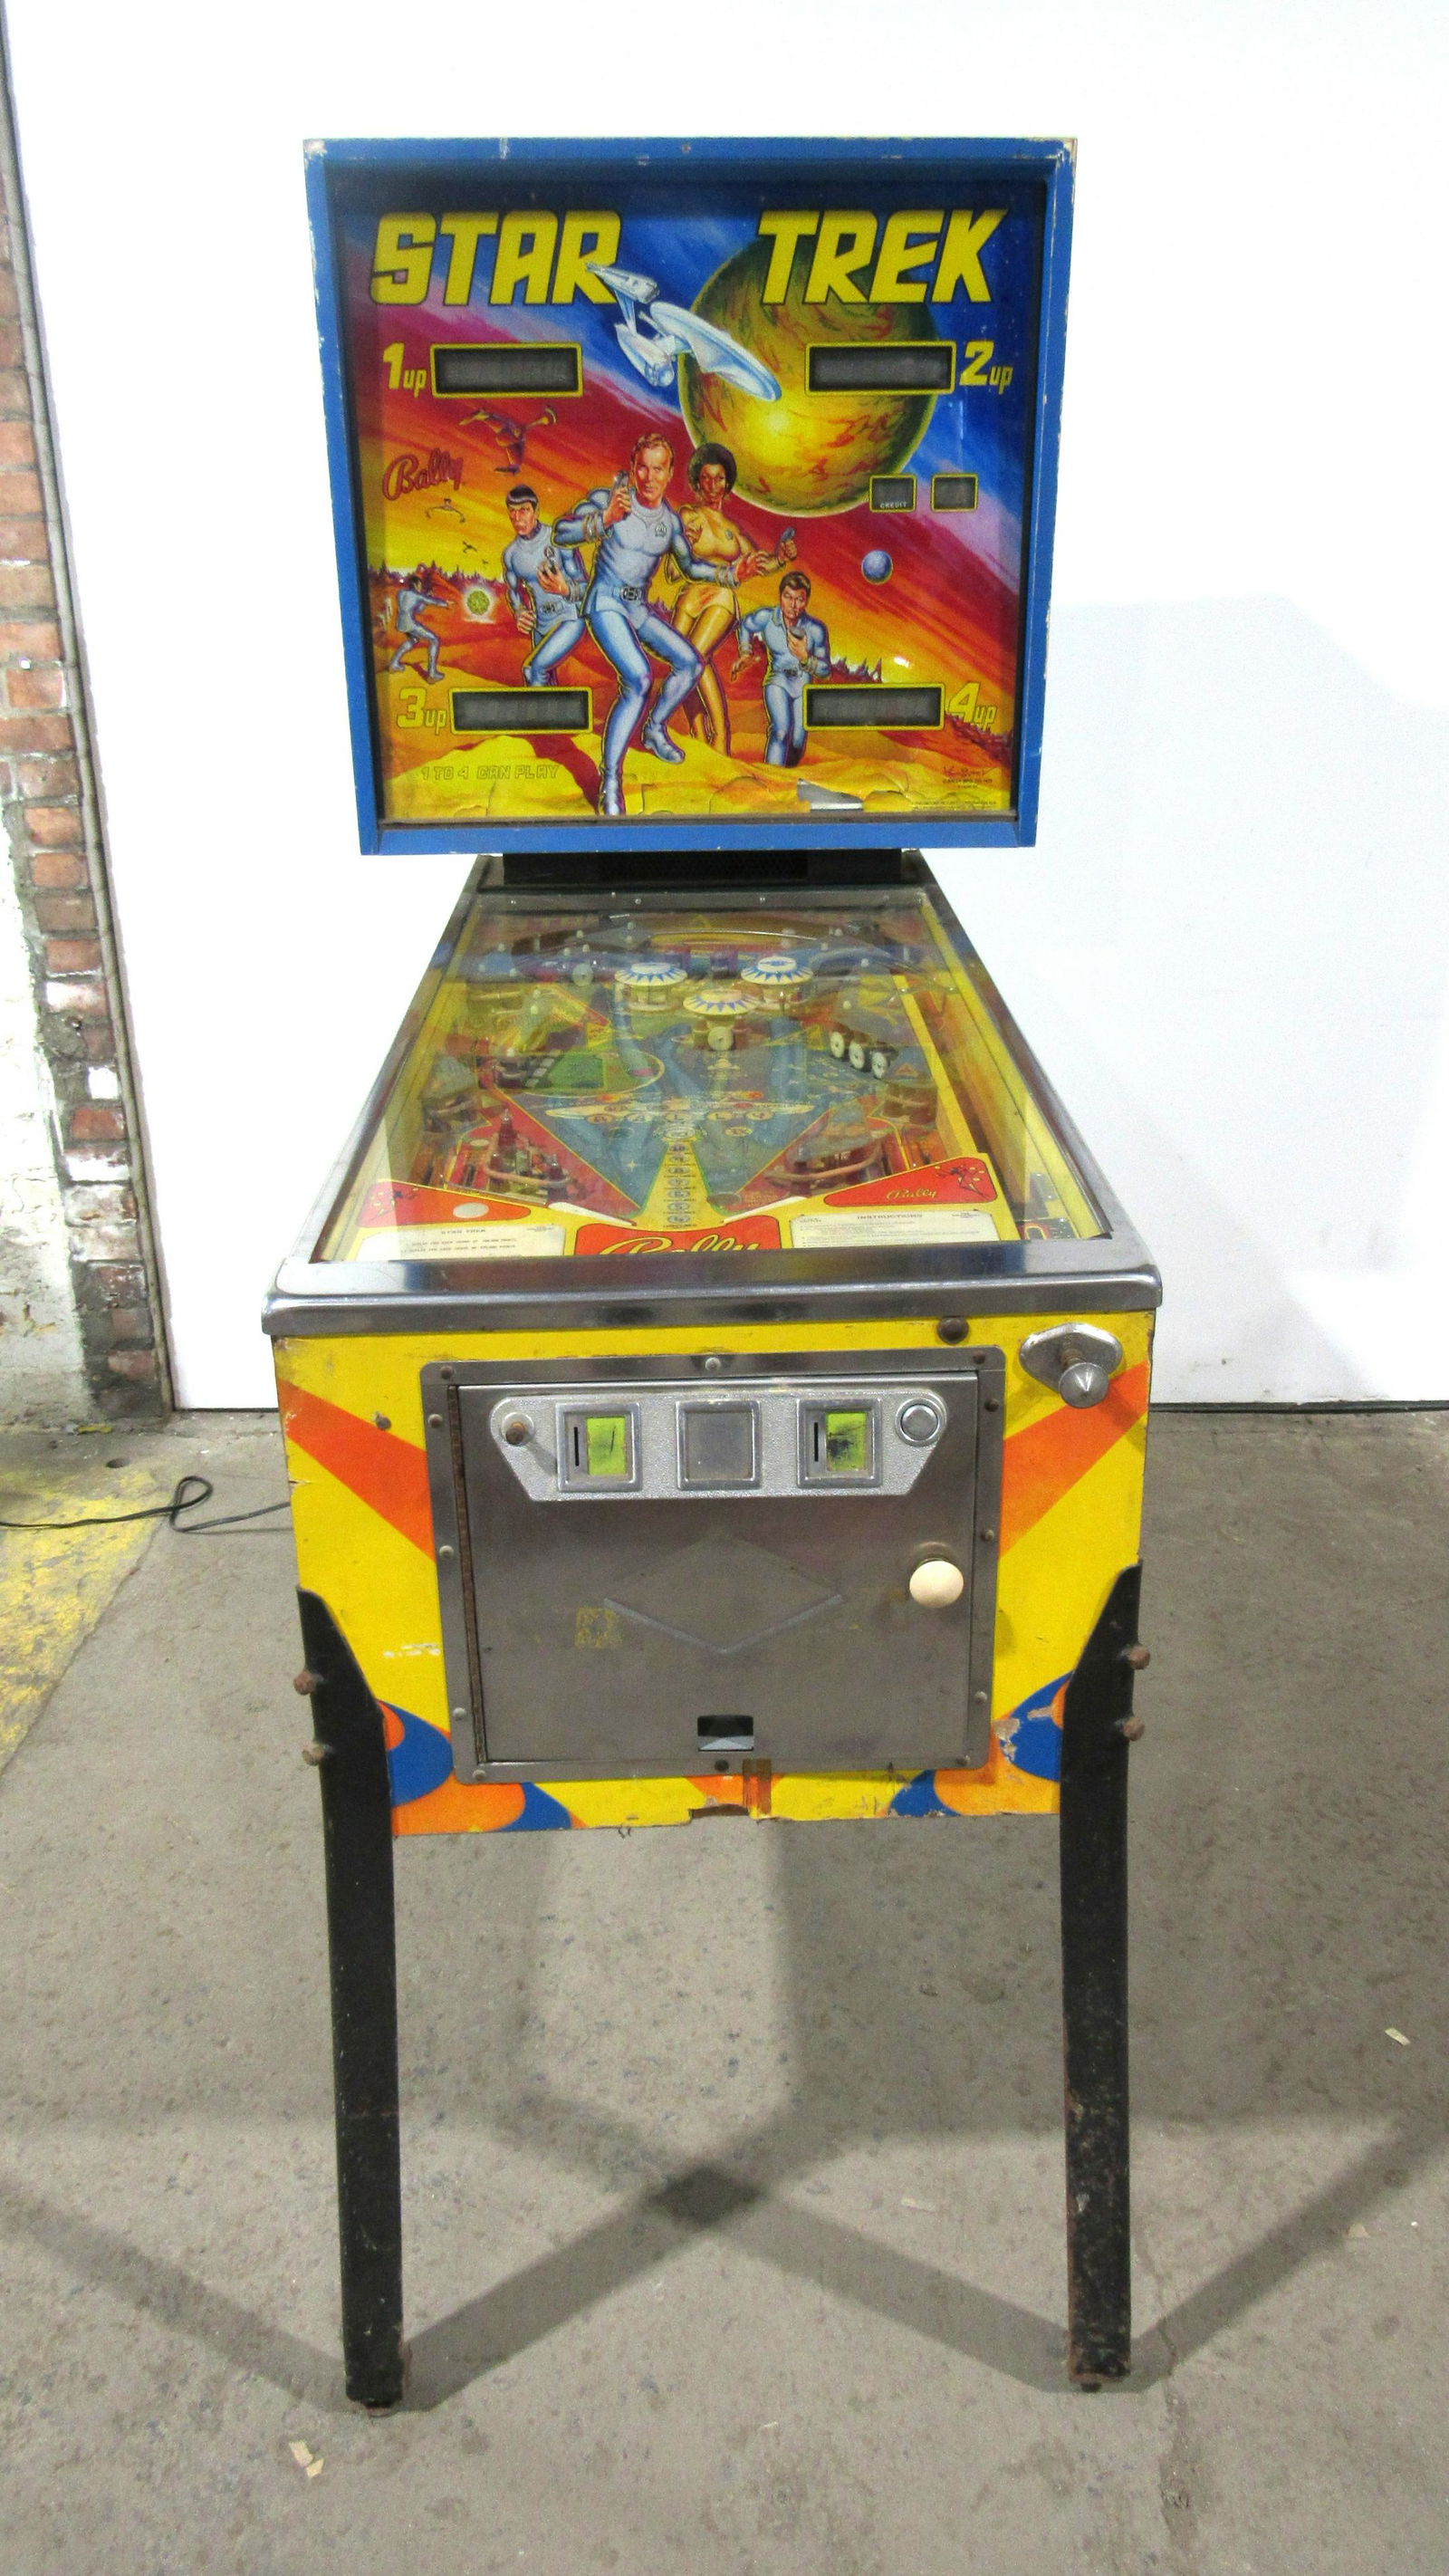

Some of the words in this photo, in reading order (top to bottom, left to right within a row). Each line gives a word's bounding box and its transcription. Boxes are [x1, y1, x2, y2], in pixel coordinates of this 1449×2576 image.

[369, 209, 622, 305] STAR
[757, 207, 1009, 304] TREK
[382, 447, 464, 501] Bally
[434, 766, 455, 780] TO
[457, 766, 469, 780] 4
[476, 764, 512, 780] CAN
[514, 764, 559, 780] PLAY
[886, 1187, 936, 1200] Bally
